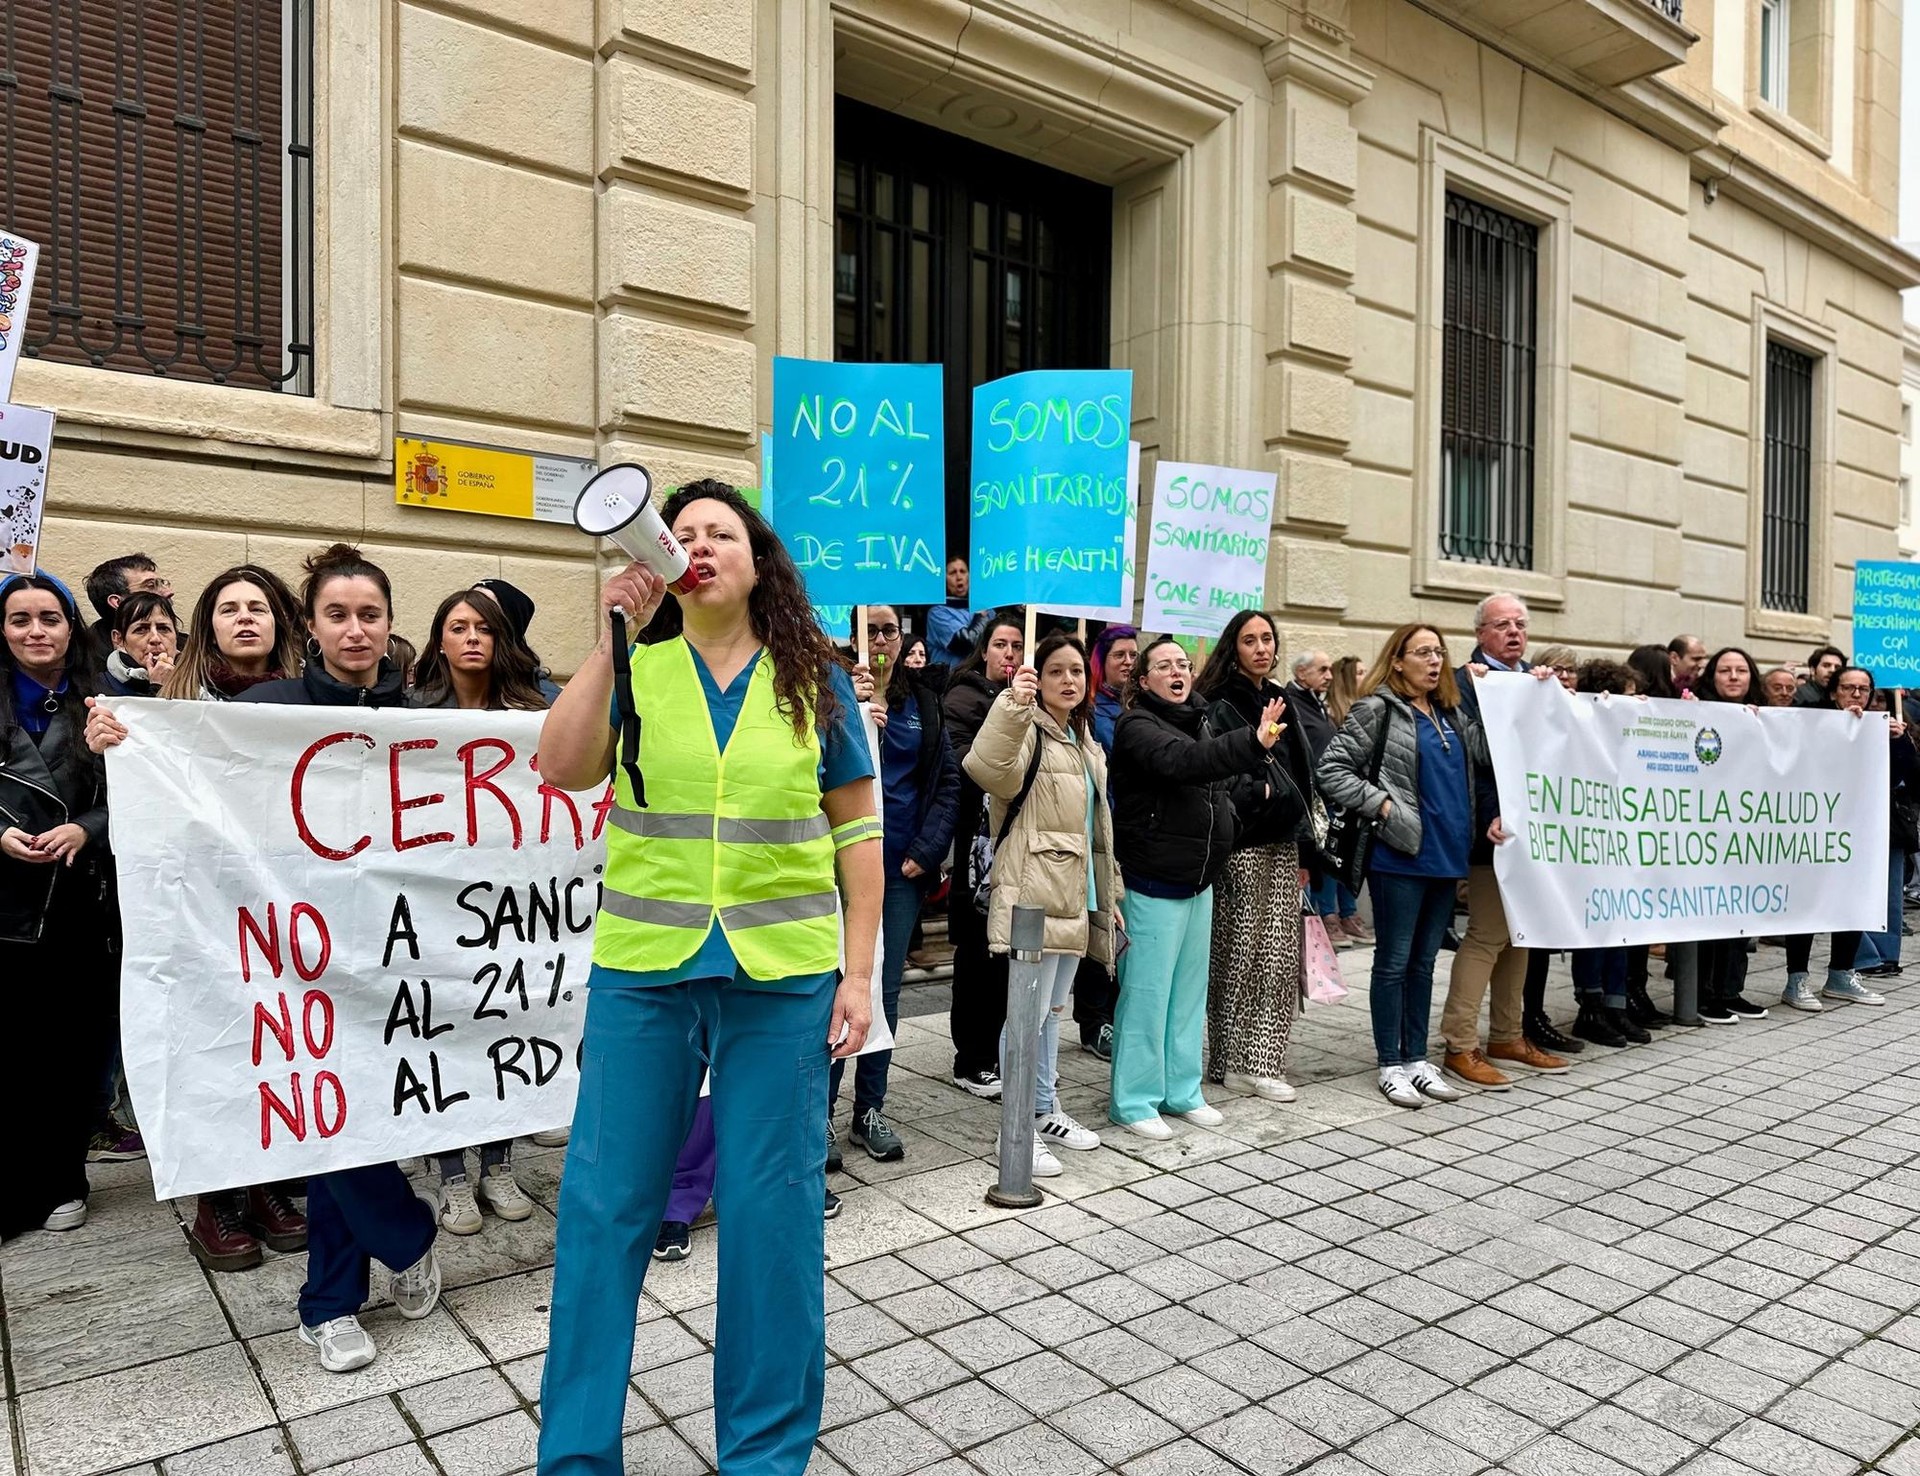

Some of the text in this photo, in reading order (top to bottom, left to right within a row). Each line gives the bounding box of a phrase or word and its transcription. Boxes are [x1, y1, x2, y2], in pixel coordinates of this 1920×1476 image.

[792, 392, 930, 441] NO AL
[987, 394, 1126, 452] SOMOS
[458, 470, 495, 481] GOBIERNO
[458, 478, 495, 489] DE ESPAÑA
[1166, 475, 1269, 523] SOMOS
[793, 531, 845, 571] DE
[1882, 635, 1908, 651] CON
[1525, 772, 1841, 824] EN DEFENSA DE LA SALUD Y
[1527, 821, 1852, 867] BIENESTAR DE LOS ANIMALES
[1584, 884, 1790, 929] ¡SOMOS SANITARIOS!
[237, 901, 332, 983] NO
[382, 893, 420, 968] A
[252, 989, 335, 1067] NO
[383, 978, 455, 1045] AL
[258, 1070, 348, 1150] NO
[393, 1050, 471, 1116] AL
[487, 1035, 564, 1101] RD
